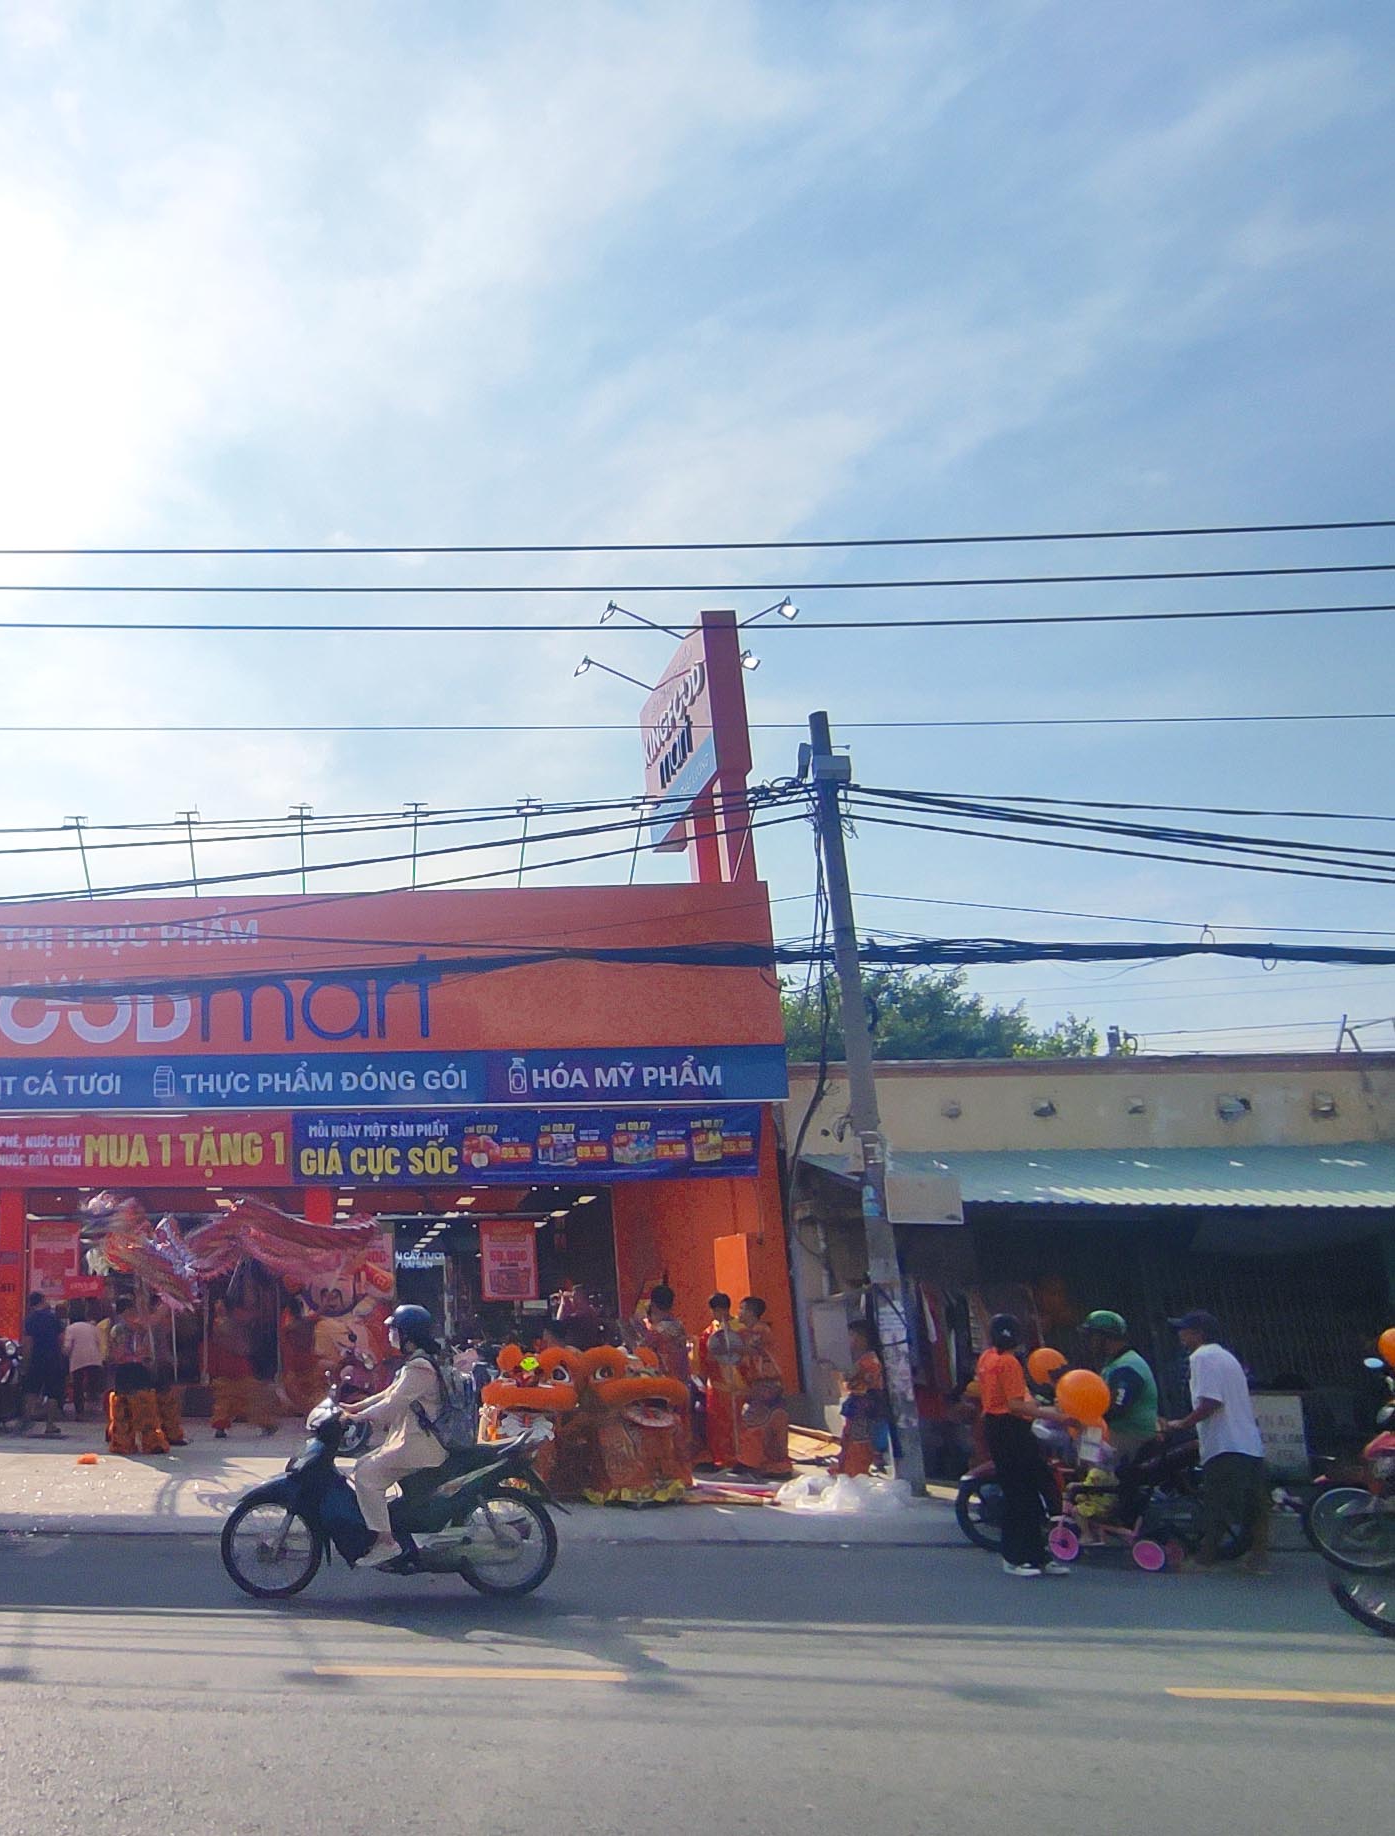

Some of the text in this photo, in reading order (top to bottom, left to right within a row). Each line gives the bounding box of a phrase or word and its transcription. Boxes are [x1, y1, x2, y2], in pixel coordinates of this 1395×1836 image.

[23, 1070, 59, 1096] CÁ
[63, 1072, 121, 1095] TƯƠI
[181, 1061, 468, 1098] THỰC PHẨM ĐÓNG GÓI
[532, 1055, 723, 1089] HÓA MỸ PHẨM
[331, 1122, 362, 1138] NGÀY
[364, 1121, 388, 1141] MỘT
[84, 1126, 286, 1178] MUA 1 TẶNG 1
[300, 1137, 459, 1182] GIÁ CỰC SỐC
